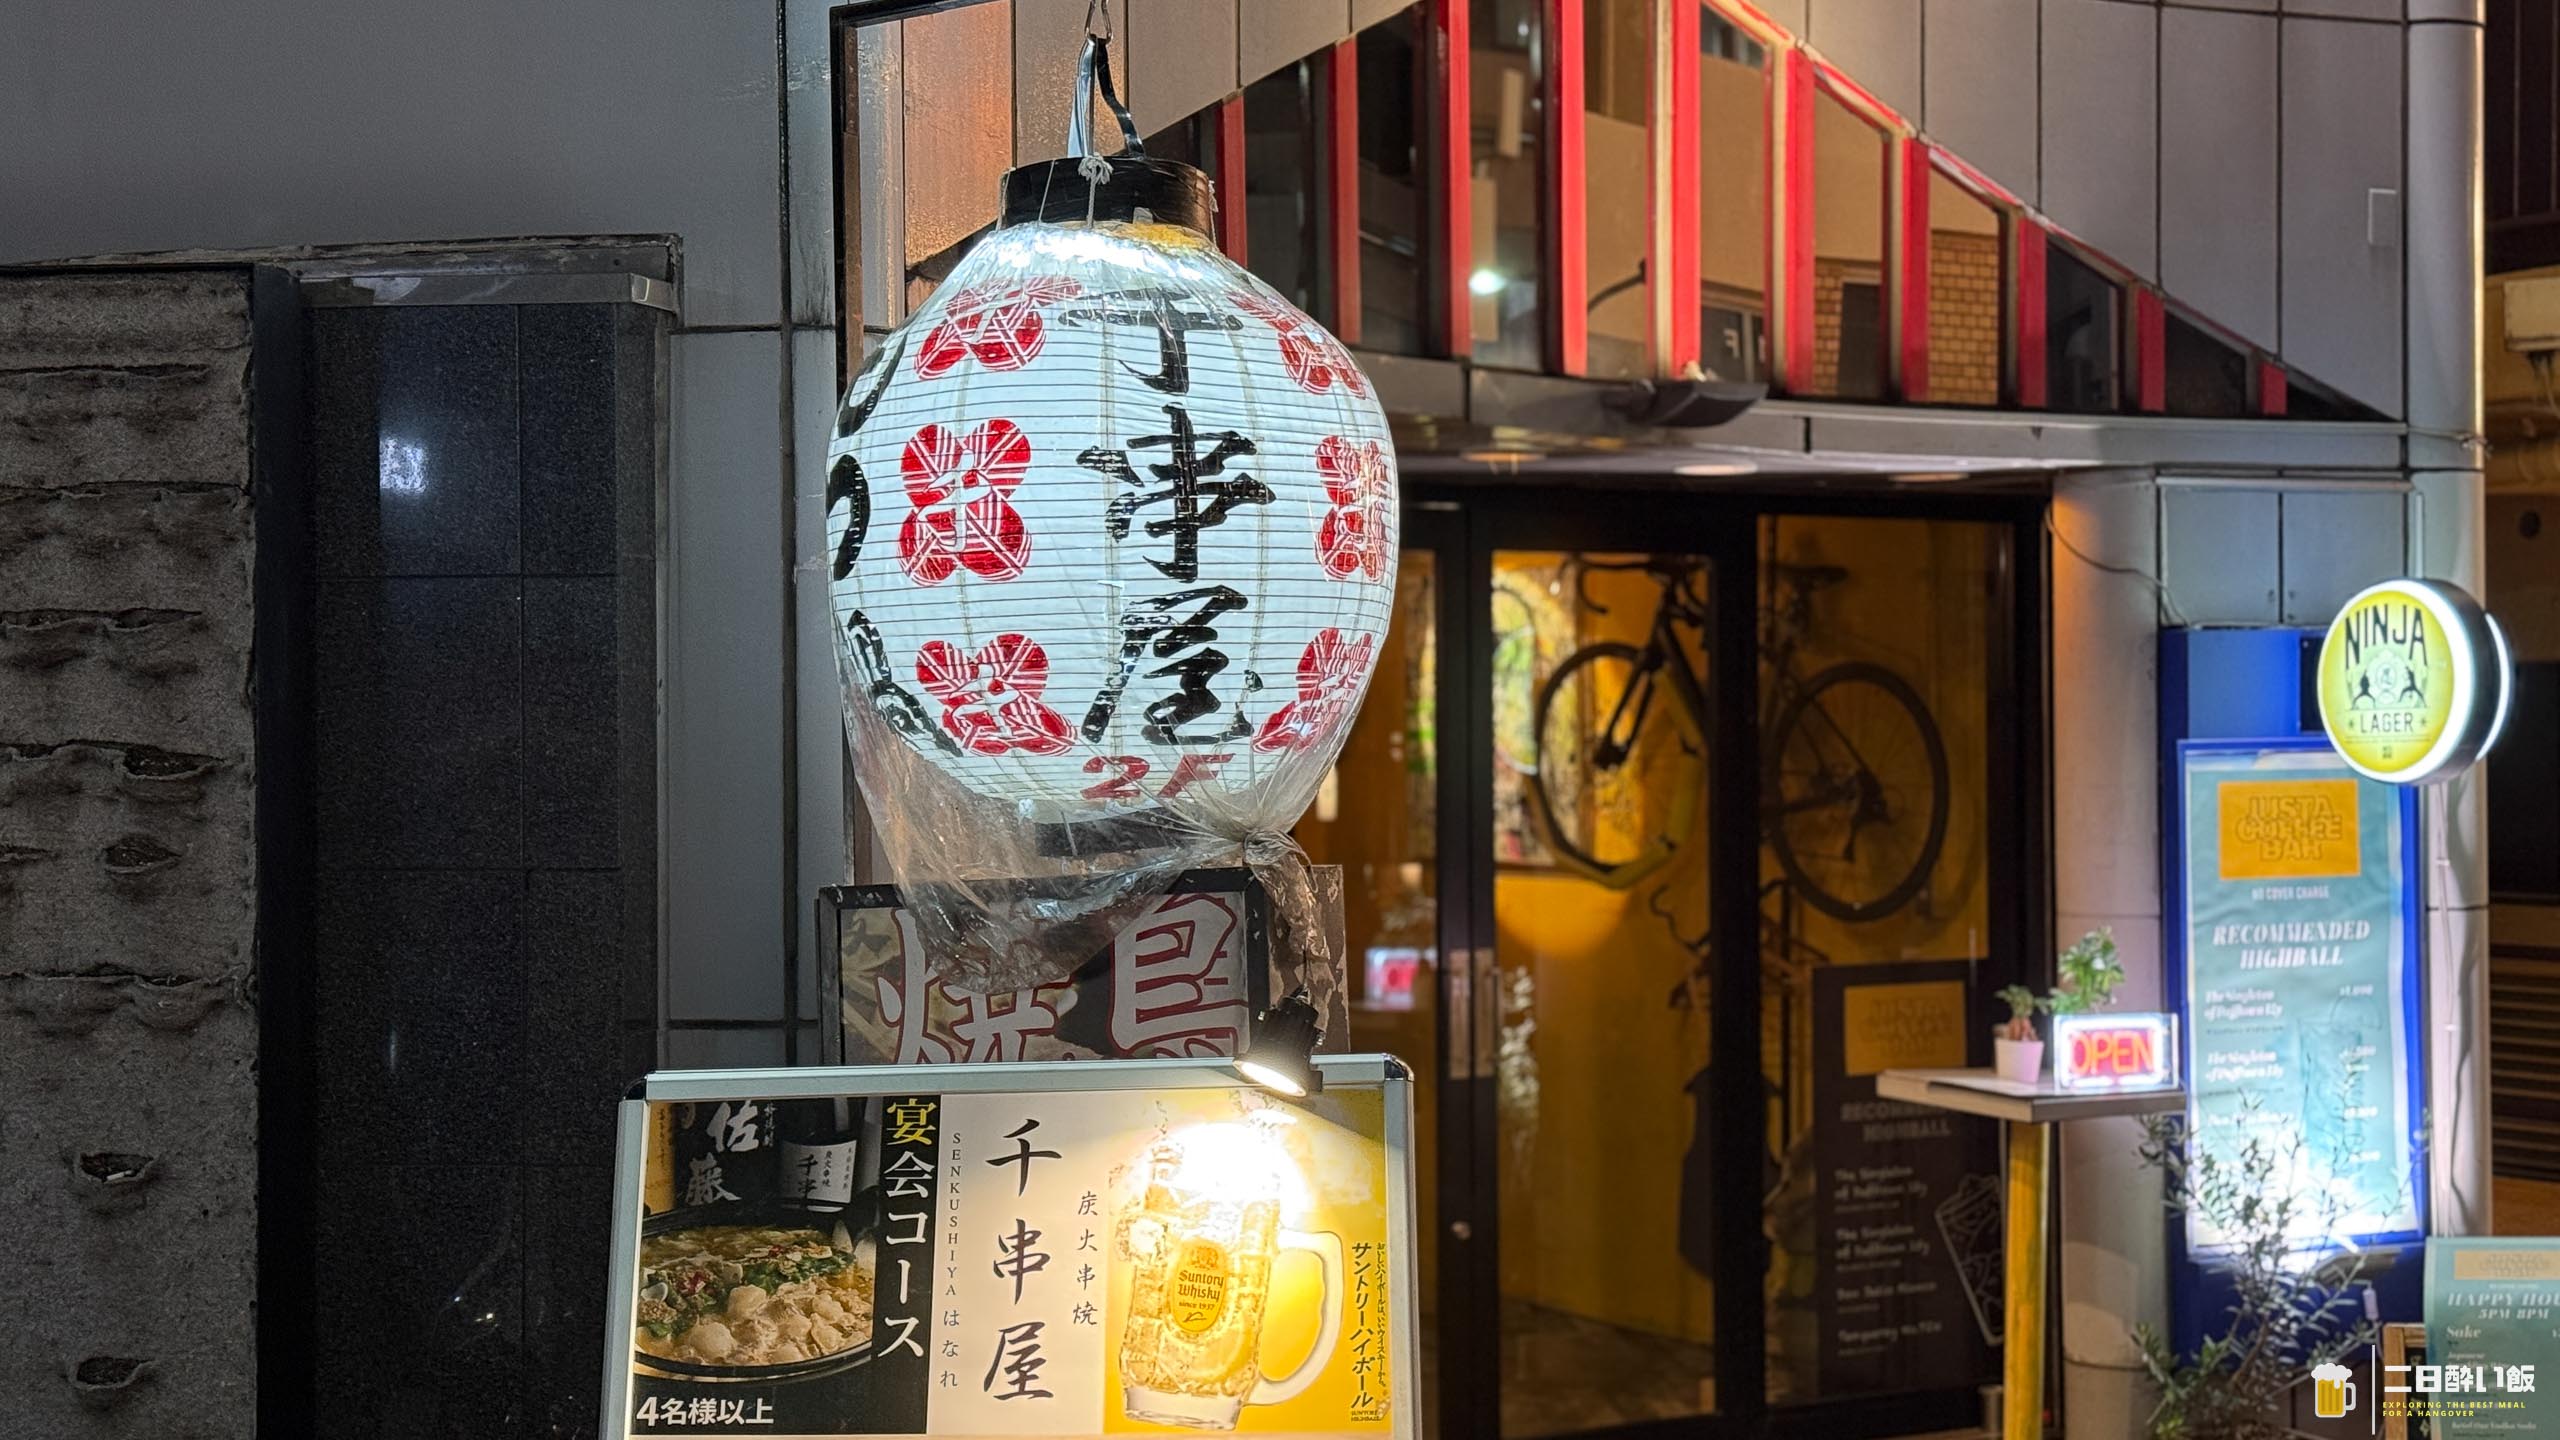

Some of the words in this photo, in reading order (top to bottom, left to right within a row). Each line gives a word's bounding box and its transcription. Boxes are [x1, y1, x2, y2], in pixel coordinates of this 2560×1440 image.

[2344, 604, 2428, 670] NINJA
[2360, 711, 2414, 734] LAGER
[2212, 920, 2371, 946] RECOMMENDED
[2239, 946, 2344, 970] HIGHBALL
[2070, 1031, 2156, 1075] OPEN
[877, 1098, 937, 1360] 宴会コース
[945, 1132, 962, 1296] SENKUSHIYA
[983, 1118, 1062, 1402] 千串屋
[1071, 1191, 1099, 1327] 炭火串焼
[1178, 1269, 1225, 1290] Suntory
[1178, 1283, 1221, 1302] Whisky
[2447, 1292, 2513, 1307] HAPPY
[2521, 1292, 2560, 1307] HO
[1350, 1242, 1376, 1409] サントリーハイボール
[2446, 1324, 2482, 1339] Sake
[939, 1309, 961, 1388] はなれ
[636, 1396, 774, 1427] 4名様以上
